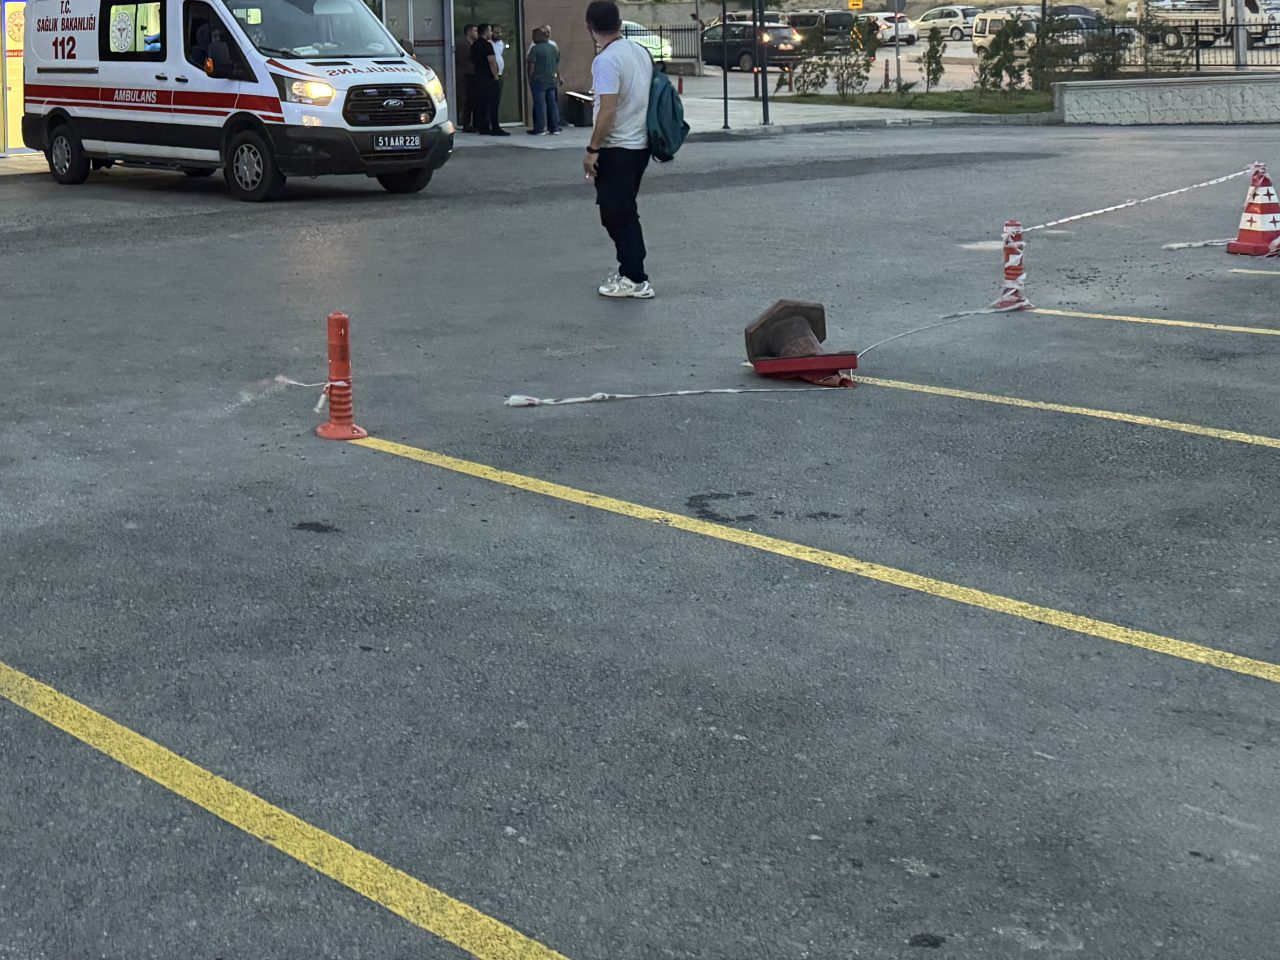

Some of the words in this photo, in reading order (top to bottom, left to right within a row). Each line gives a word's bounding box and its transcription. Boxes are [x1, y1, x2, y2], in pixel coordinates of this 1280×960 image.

[60, 0, 72, 14] T.C.
[37, 16, 58, 32] SAĞLIK
[61, 14, 96, 31] BAKANLIĞI
[52, 36, 77, 59] 112
[114, 90, 157, 103] AMBULANS
[378, 136, 389, 146] 51
[390, 136, 405, 146] AAR
[405, 136, 420, 146] 228
